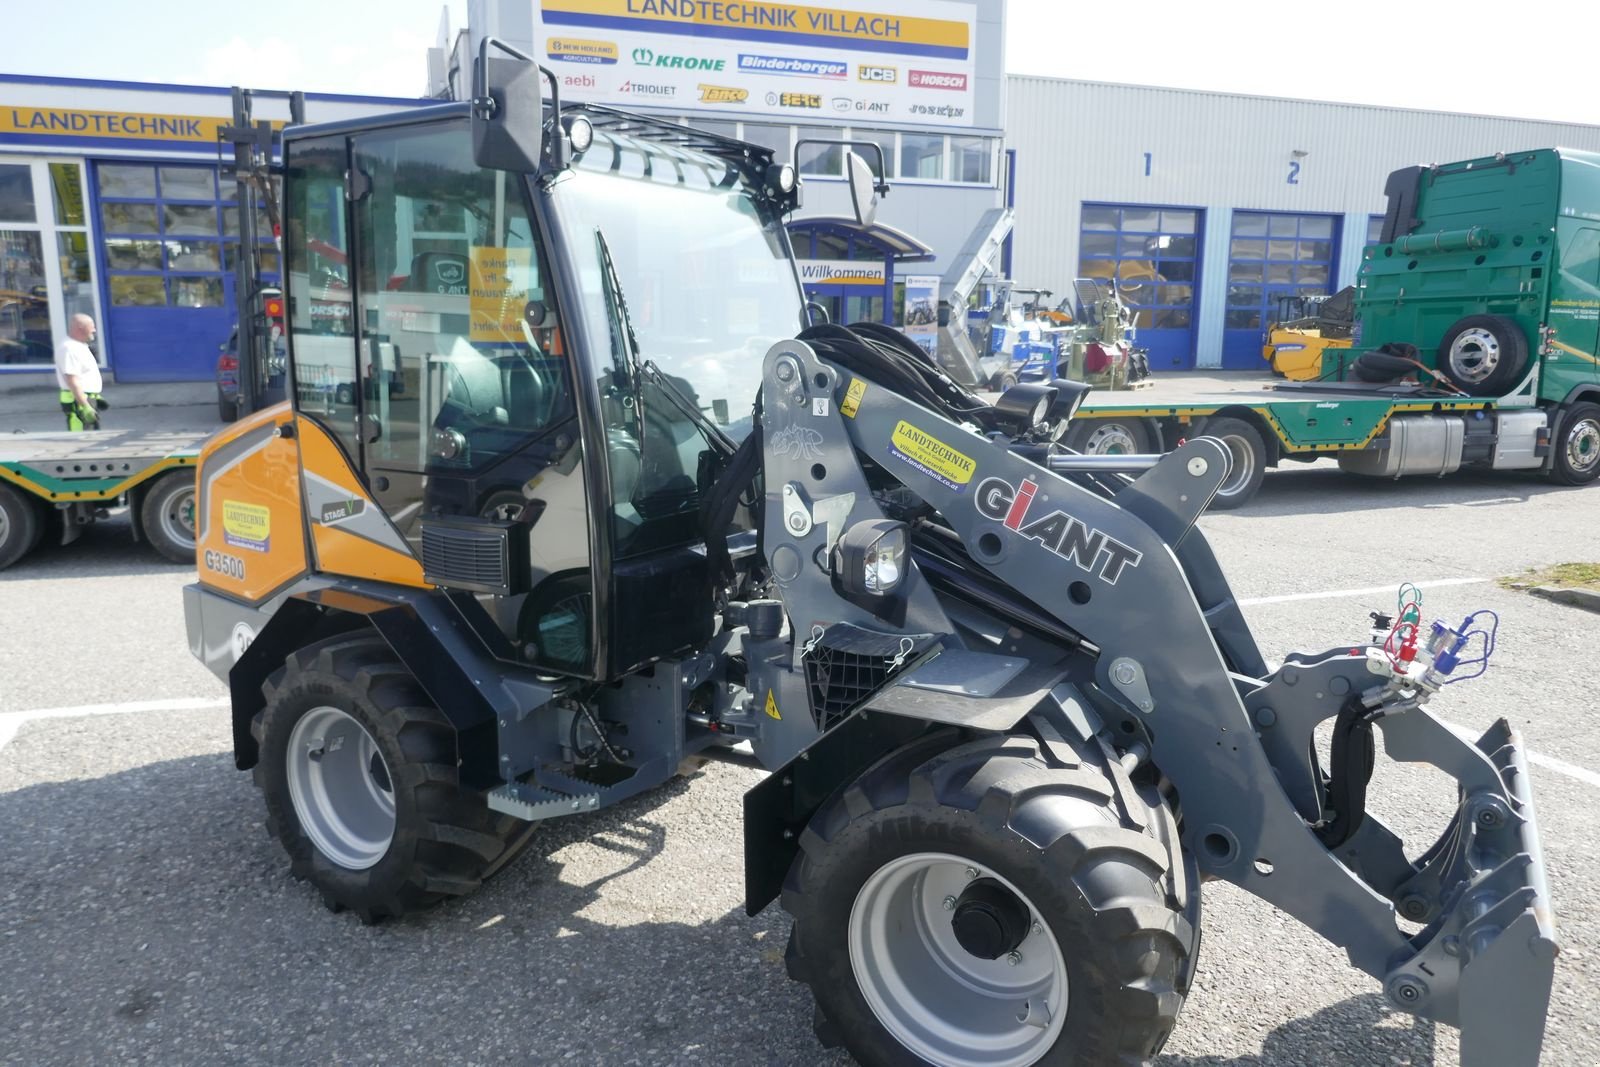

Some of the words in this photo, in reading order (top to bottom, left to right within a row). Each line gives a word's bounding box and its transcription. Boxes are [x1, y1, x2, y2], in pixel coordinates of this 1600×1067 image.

[627, 0, 797, 28] LANDTECHNIK
[808, 12, 900, 37] VILLACH
[563, 55, 602, 63] AGRICULTURE
[655, 55, 726, 71] KRONE
[741, 56, 845, 74] Binderberger
[565, 74, 595, 87] aebi
[860, 66, 896, 81] JCB
[920, 74, 964, 88] HORSCH
[697, 83, 748, 103] Tanco
[12, 110, 202, 137] LANDTECHNIK
[1143, 151, 1153, 177] 1
[1287, 161, 1300, 185] 2
[801, 265, 882, 280] Willkommen
[438, 285, 467, 296] GANT
[898, 424, 972, 472] LANDTECHNIK
[899, 443, 918, 458] Villach
[891, 449, 959, 491] www.landtechnik.co.at
[226, 509, 265, 527] LANDTECHNIK
[324, 508, 346, 522] STAGE
[204, 549, 245, 581] G3500
